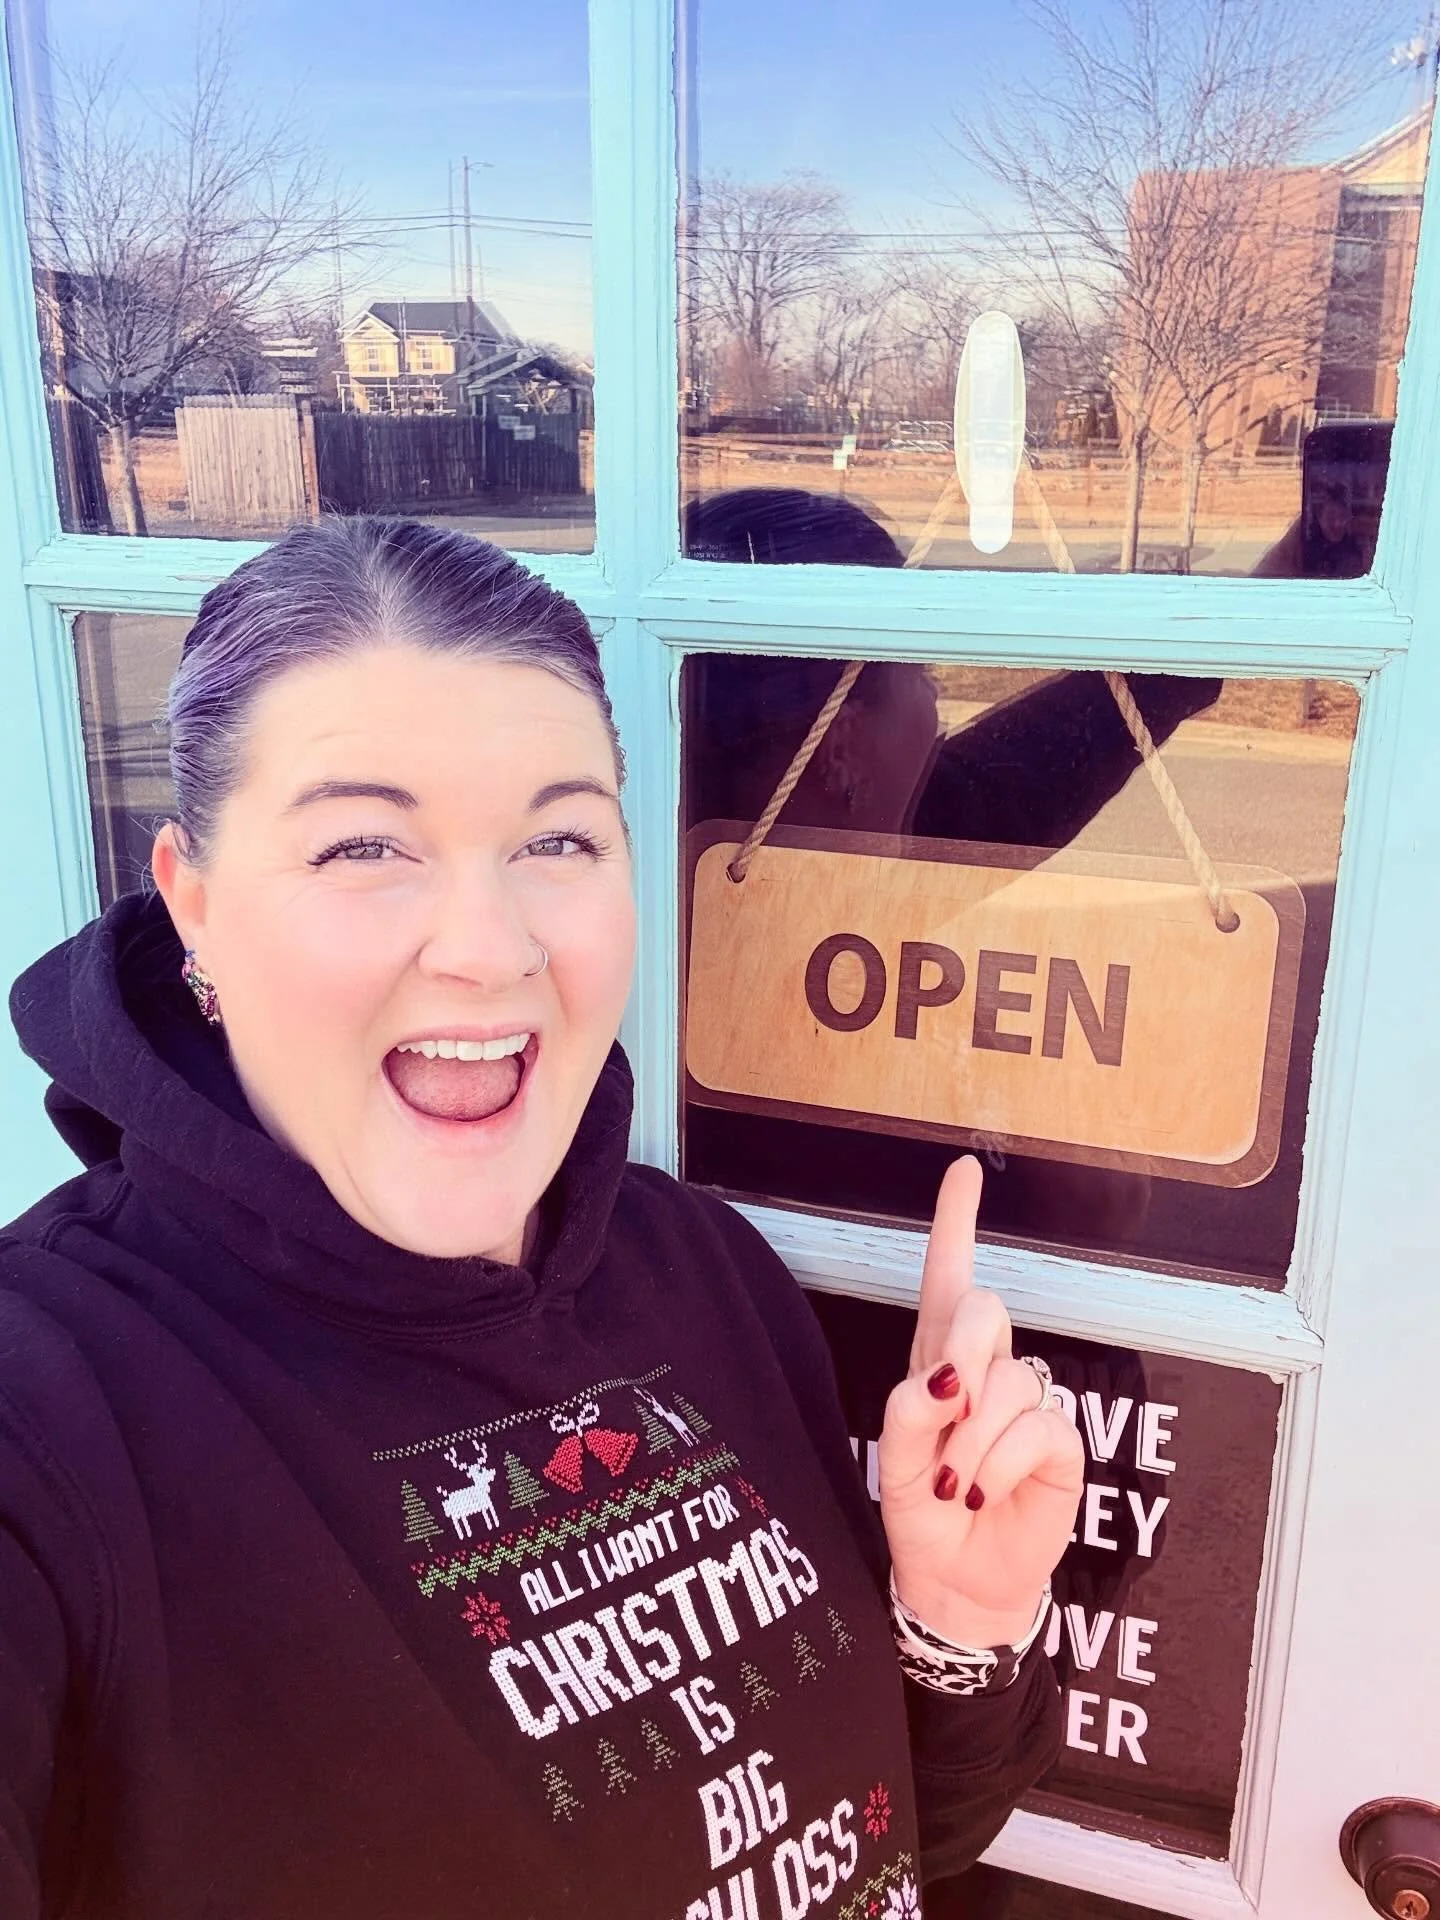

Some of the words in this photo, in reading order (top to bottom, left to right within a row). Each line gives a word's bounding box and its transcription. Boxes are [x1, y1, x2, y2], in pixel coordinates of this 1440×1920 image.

[804, 933, 1131, 1067] OPEN
[519, 1560, 584, 1616] ALL
[578, 1548, 602, 1590] I
[594, 1509, 679, 1583] WANT
[681, 1484, 741, 1542] FOR
[1069, 1482, 1171, 1558] EY
[489, 1517, 819, 1740] CHRISTMAS
[1044, 1599, 1159, 1686] VE
[669, 1675, 736, 1755] IS
[1057, 1685, 1148, 1766] ER
[698, 1748, 788, 1870] BIG
